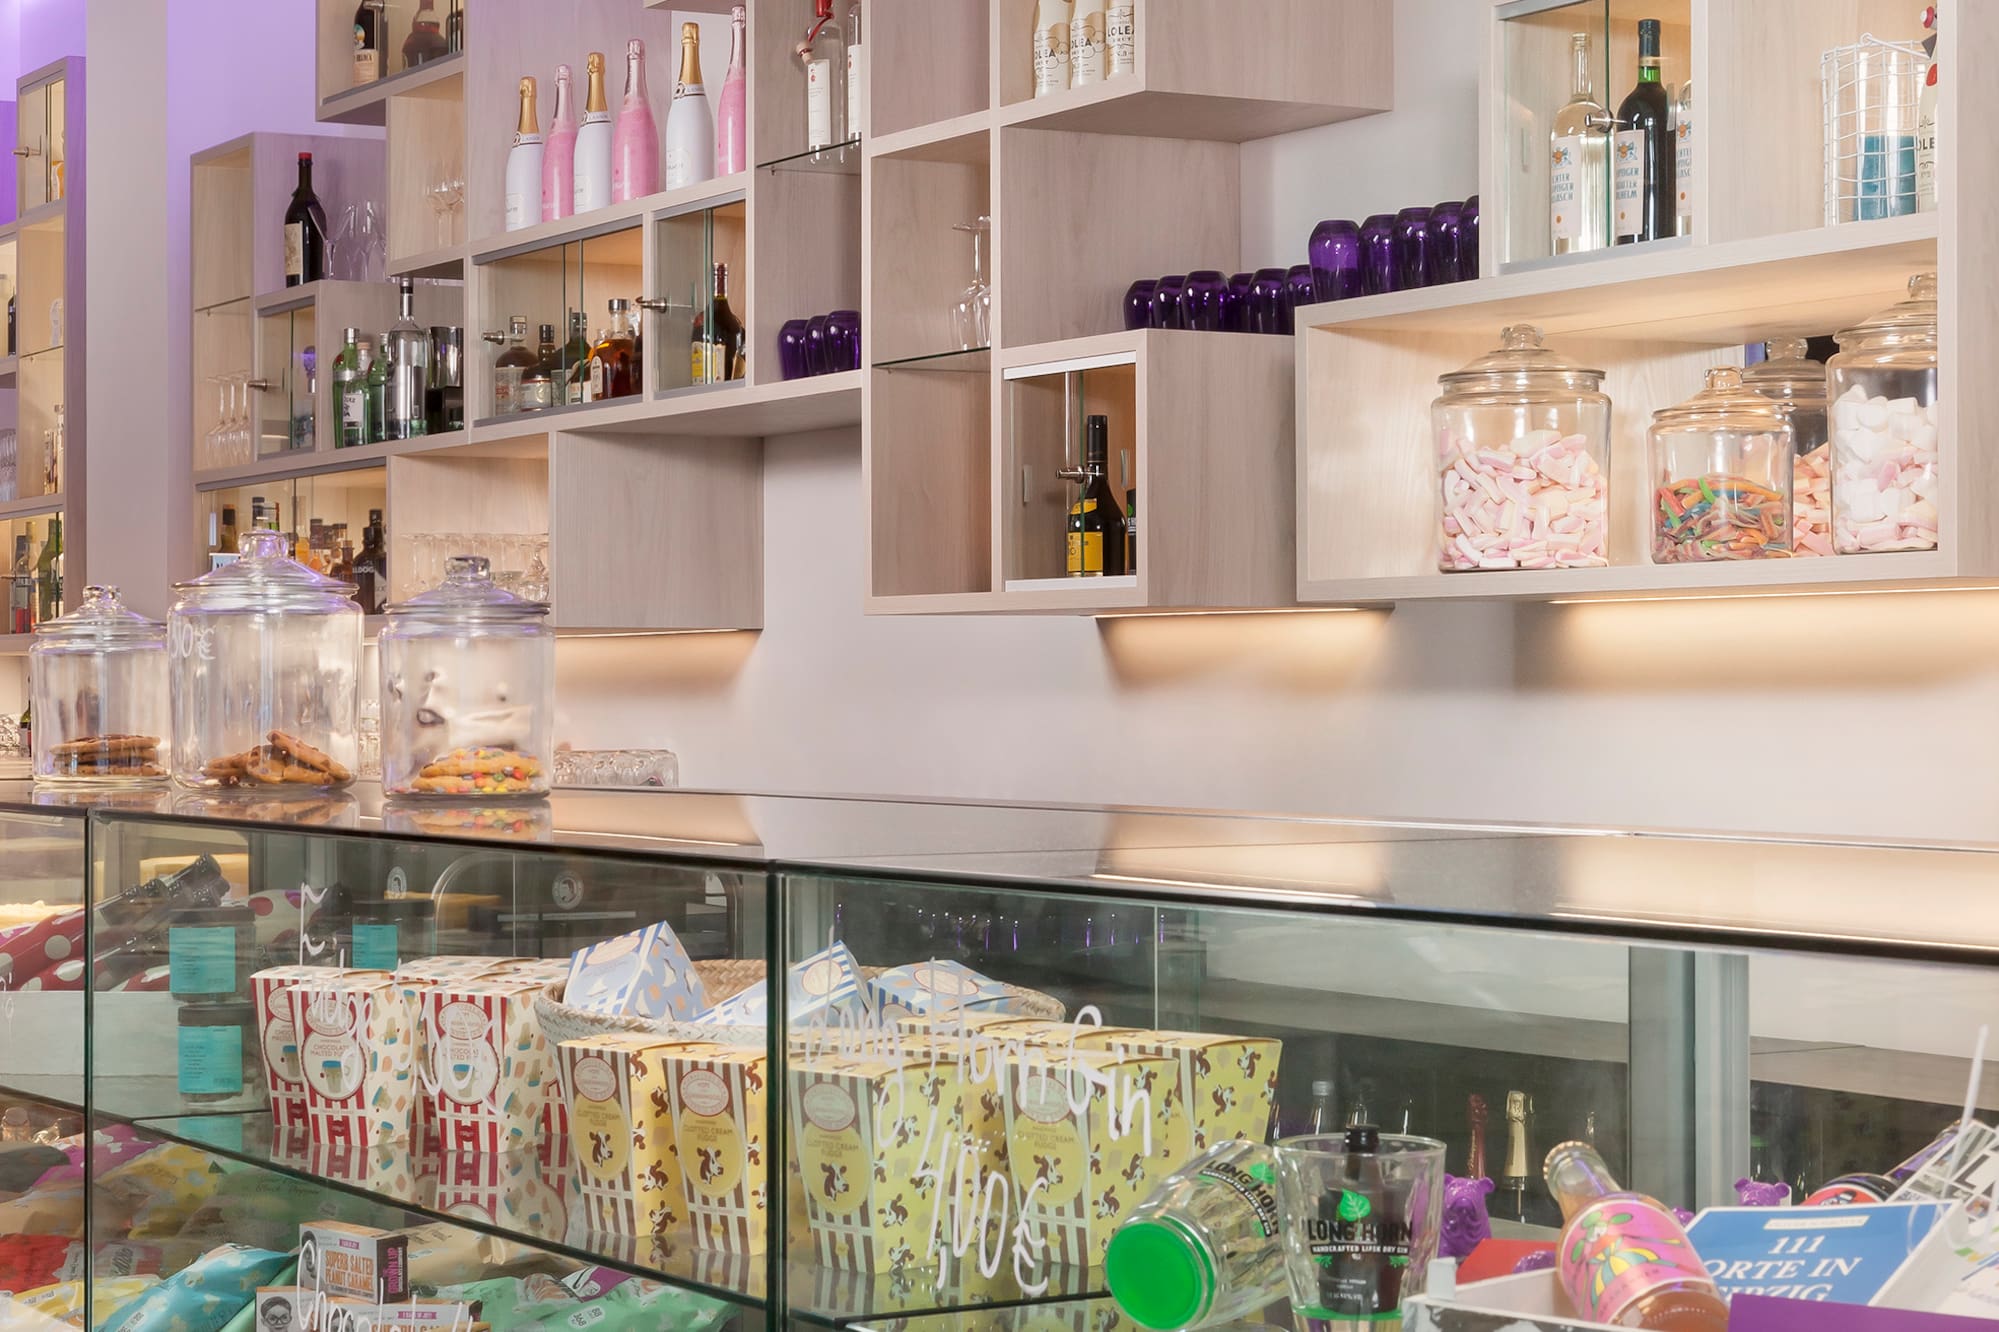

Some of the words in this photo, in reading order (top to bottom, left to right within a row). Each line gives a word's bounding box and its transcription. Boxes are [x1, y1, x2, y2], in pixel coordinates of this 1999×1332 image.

[1066, 1004, 1152, 1157] Gin
[1206, 1160, 1253, 1185] LONG
[912, 1105, 1049, 1295] 4,00€
[1307, 1219, 1356, 1241] LONG
[1312, 1245, 1360, 1253] HANDCRAFTED
[1768, 1235, 1826, 1255] 111
[325, 1250, 349, 1271] SUPERB
[350, 1254, 374, 1276] SALTED
[1703, 1259, 1806, 1280] ORTE
[1807, 1256, 1863, 1278] IN
